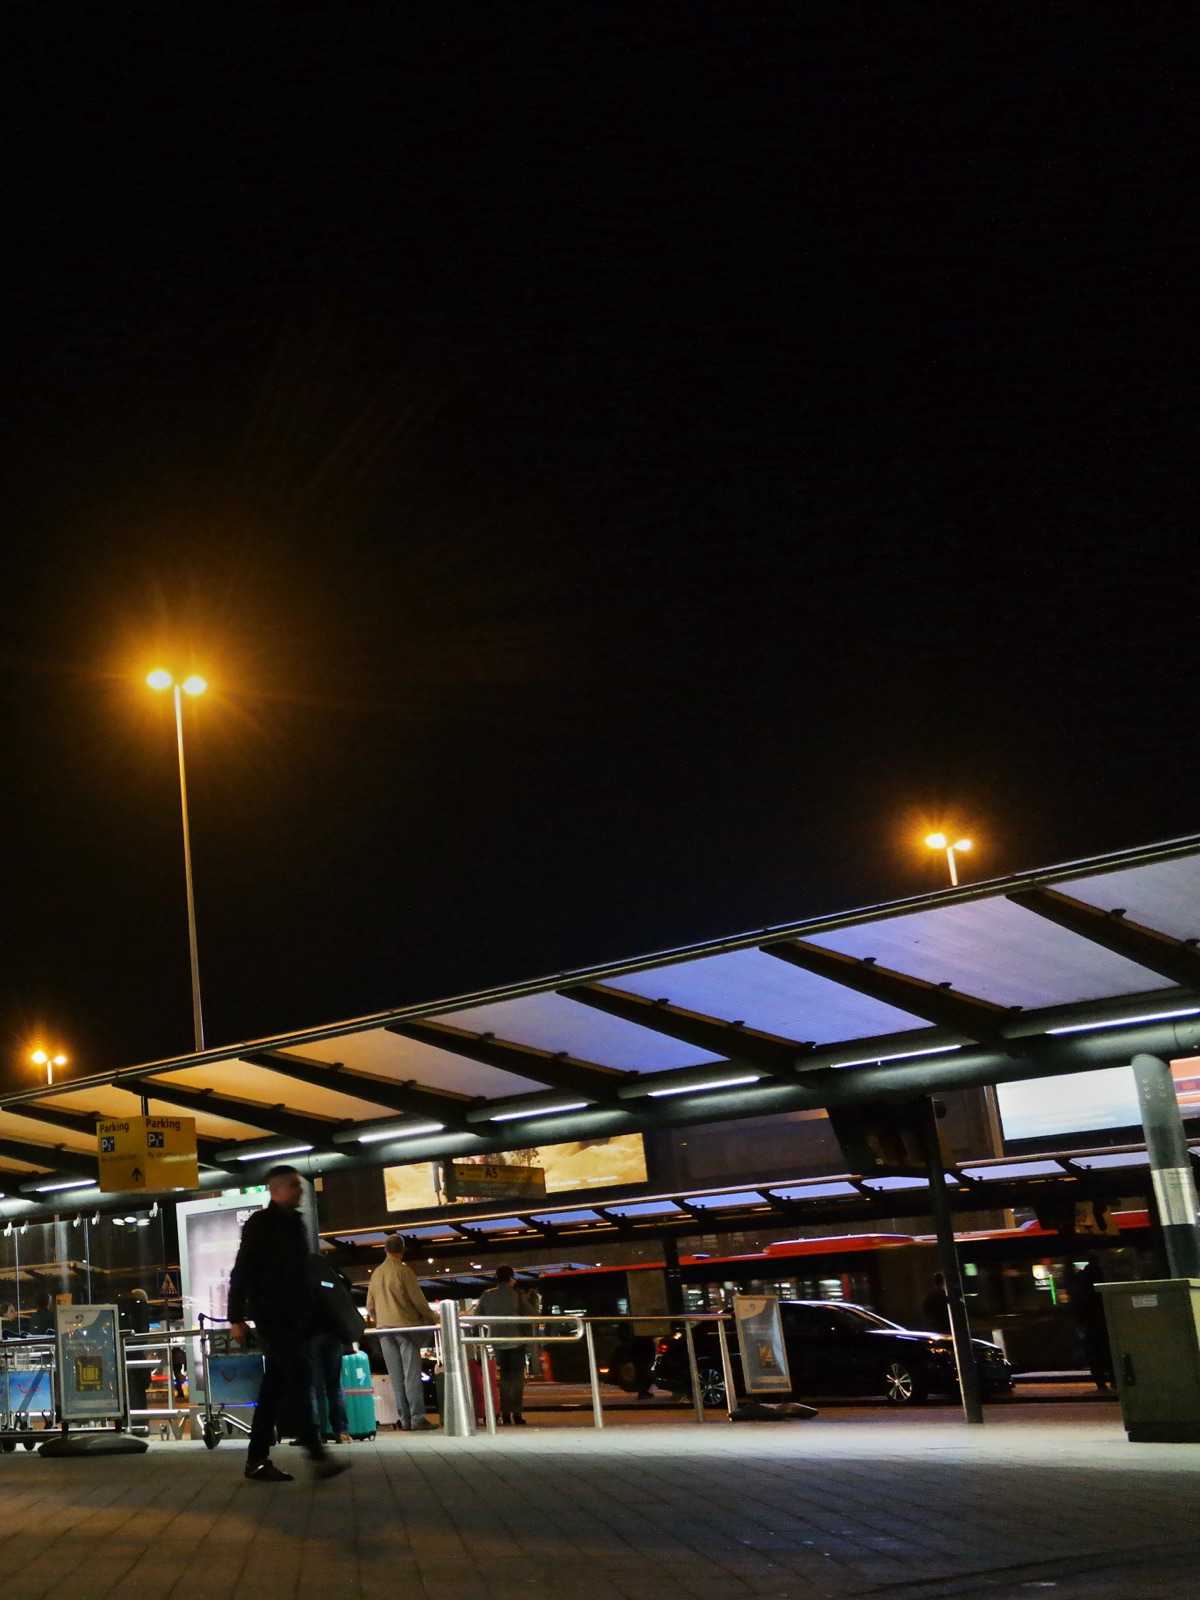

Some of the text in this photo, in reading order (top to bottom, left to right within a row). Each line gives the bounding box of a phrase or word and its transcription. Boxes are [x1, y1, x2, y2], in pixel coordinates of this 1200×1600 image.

[100, 1122, 130, 1133] Parking
[146, 1118, 181, 1131] Parking
[485, 1167, 498, 1179] A5
